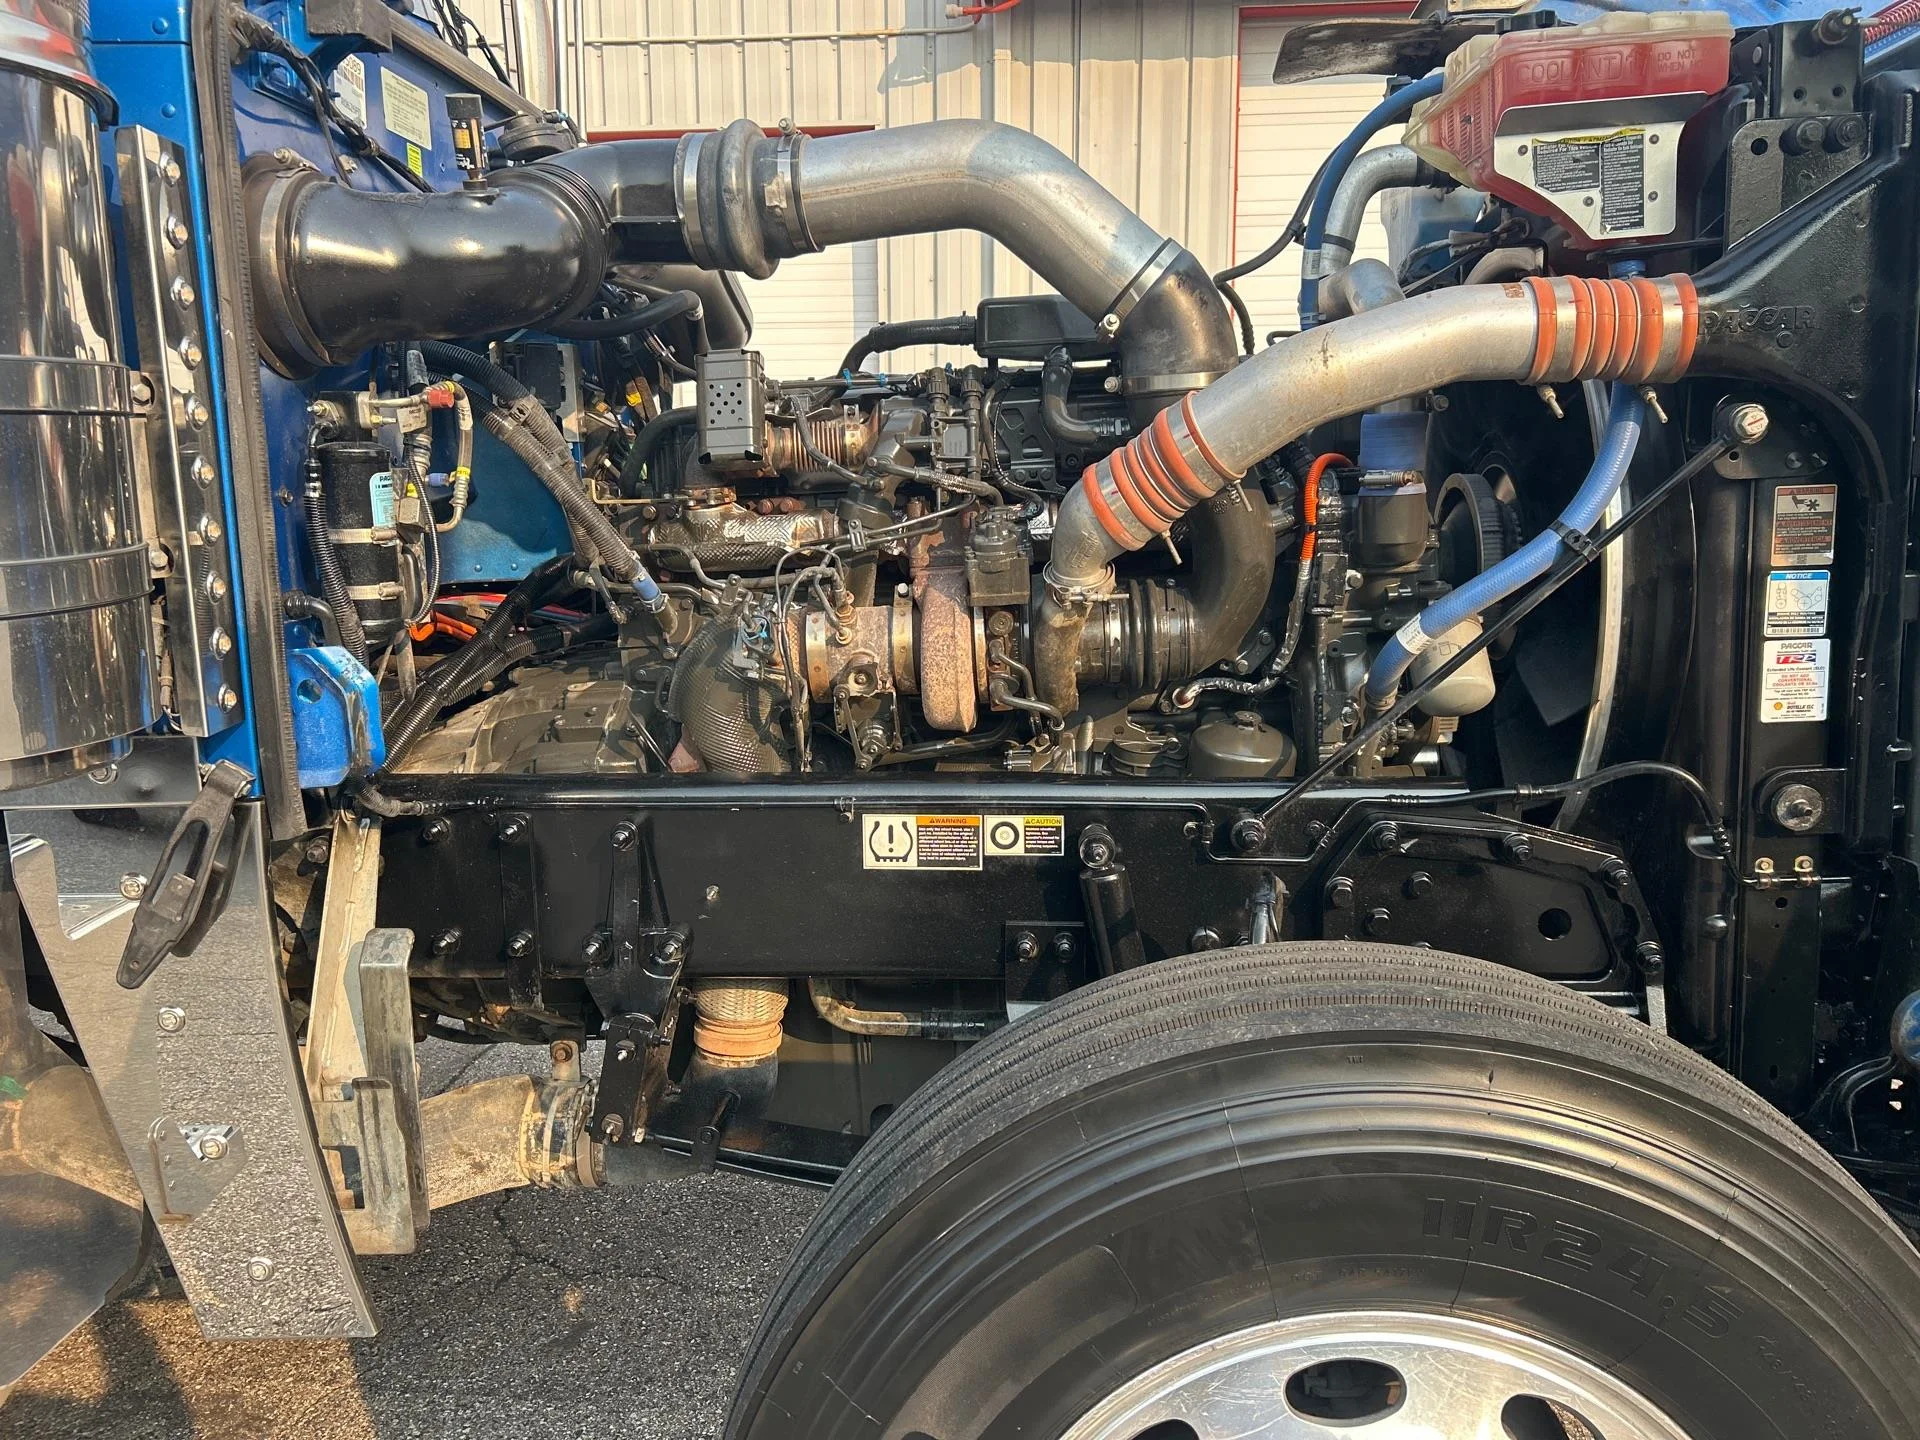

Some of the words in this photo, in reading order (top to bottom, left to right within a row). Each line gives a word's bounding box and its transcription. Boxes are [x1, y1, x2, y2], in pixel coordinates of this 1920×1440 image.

[1657, 52, 1672, 62] DO
[1677, 48, 1697, 60] NOT
[1517, 54, 1620, 83] COOLANT
[1698, 305, 1817, 335] PACCAR
[1780, 642, 1813, 650] PACCAR
